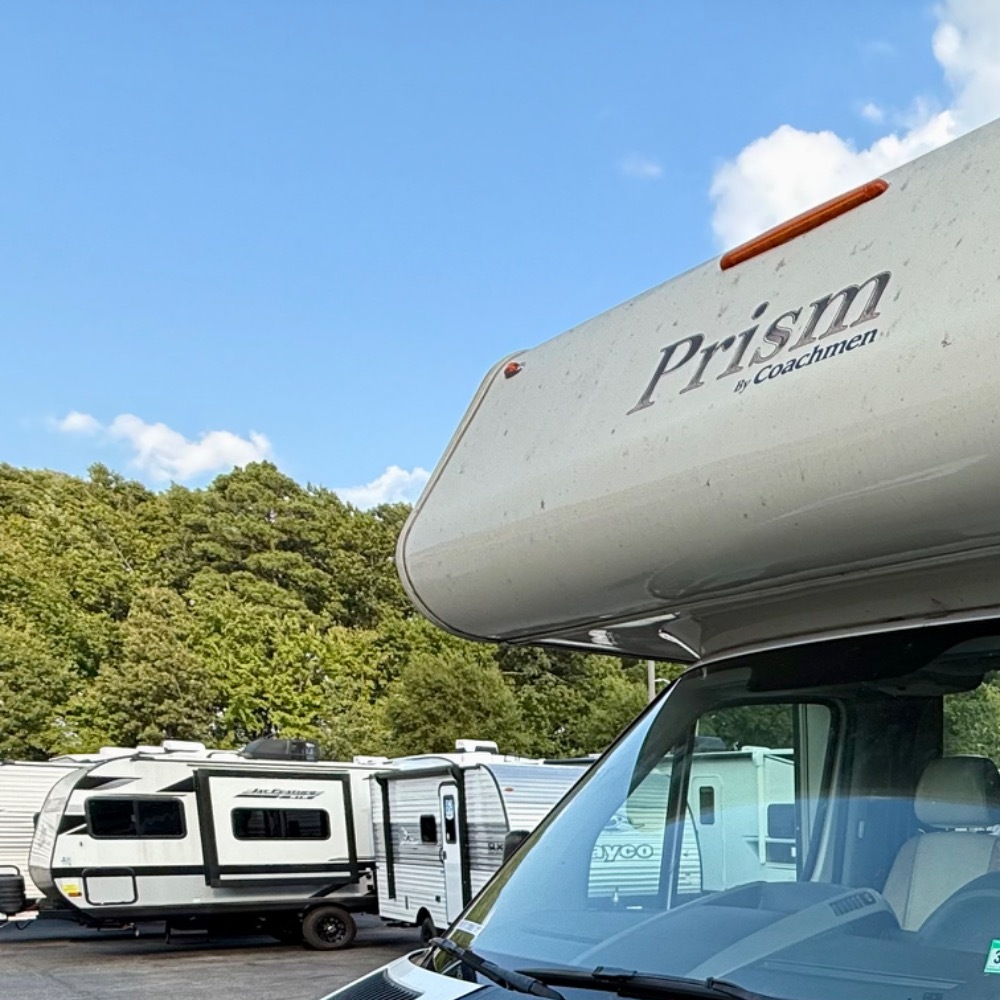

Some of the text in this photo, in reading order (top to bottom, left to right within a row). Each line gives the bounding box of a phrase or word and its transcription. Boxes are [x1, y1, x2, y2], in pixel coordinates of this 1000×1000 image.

[626, 271, 892, 415] Prism
[734, 328, 878, 393] By Coachmen
[592, 844, 654, 862] ayco
